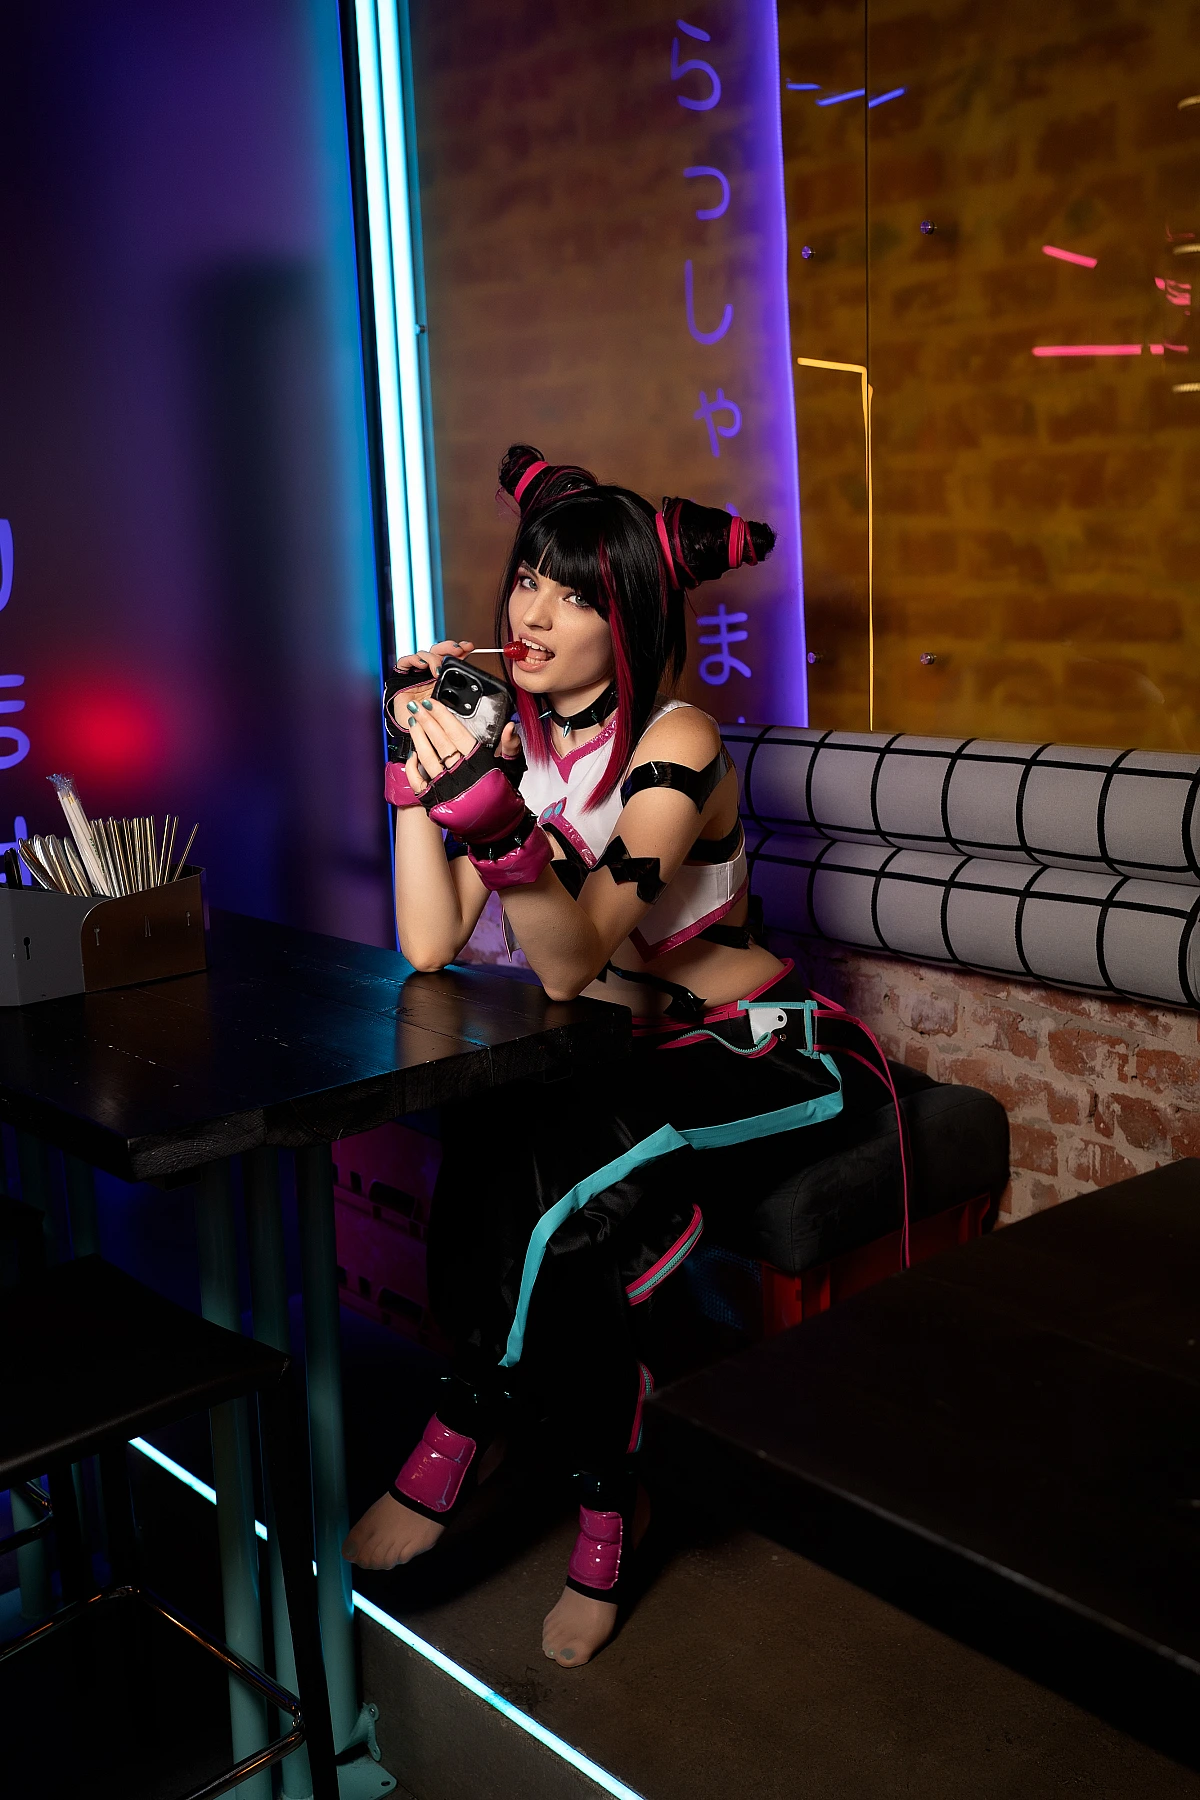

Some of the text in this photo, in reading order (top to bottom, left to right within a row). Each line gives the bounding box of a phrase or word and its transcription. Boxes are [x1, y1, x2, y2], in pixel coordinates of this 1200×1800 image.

[670, 18, 752, 724] らっしゃま
